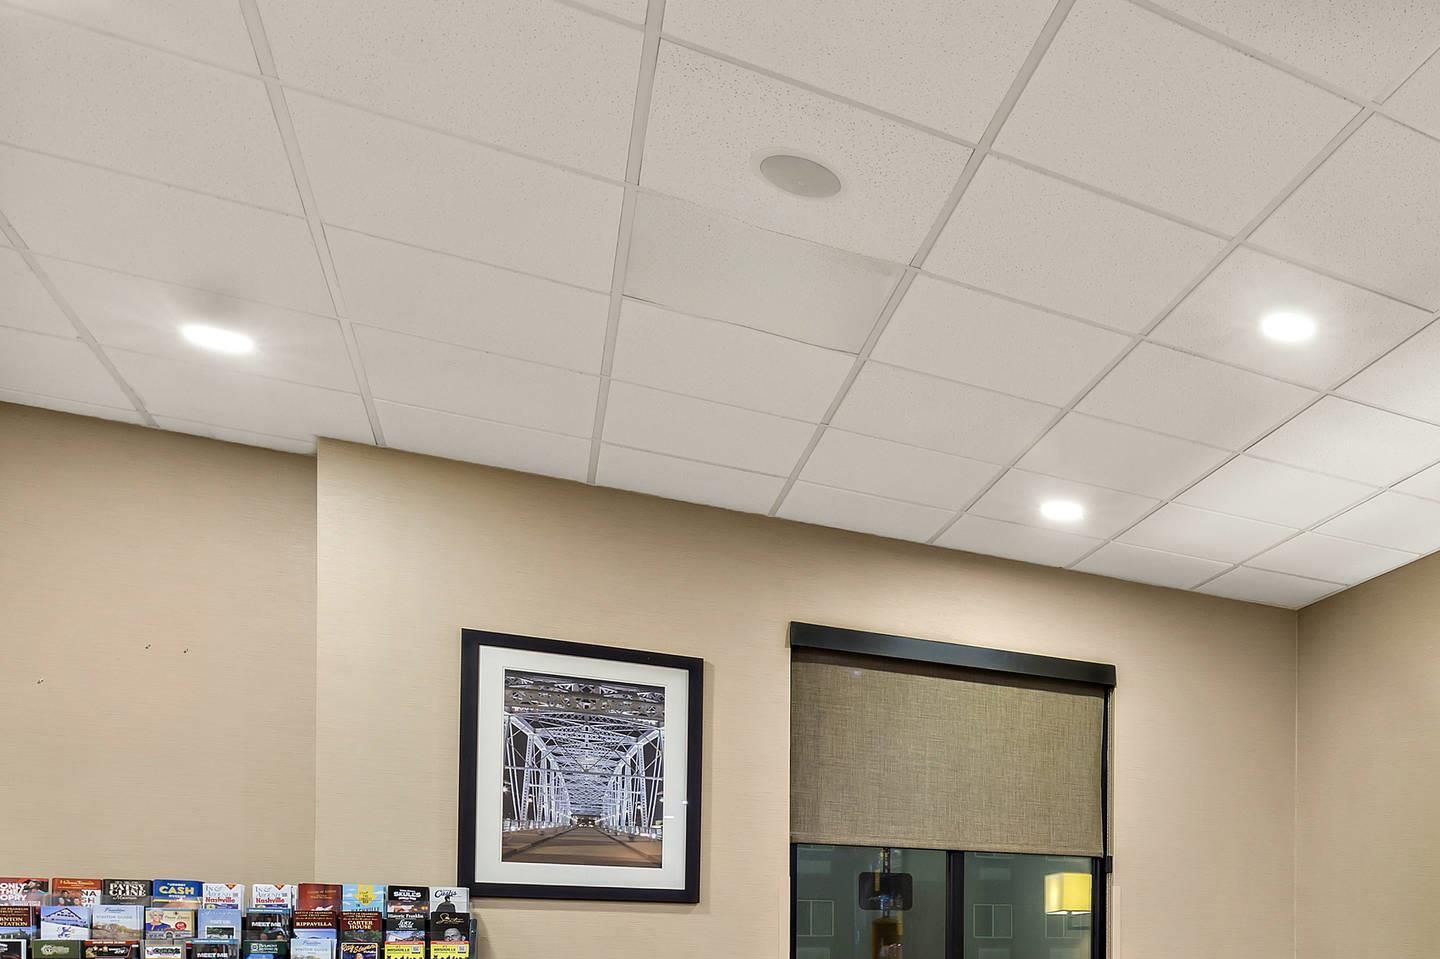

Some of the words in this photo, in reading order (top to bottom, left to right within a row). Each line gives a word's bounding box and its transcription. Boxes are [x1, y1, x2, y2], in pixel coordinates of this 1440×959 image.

[0, 882, 27, 890] ONLY
[109, 883, 146, 891] PATSY
[109, 889, 147, 897] CLINE
[159, 886, 194, 895] CASH
